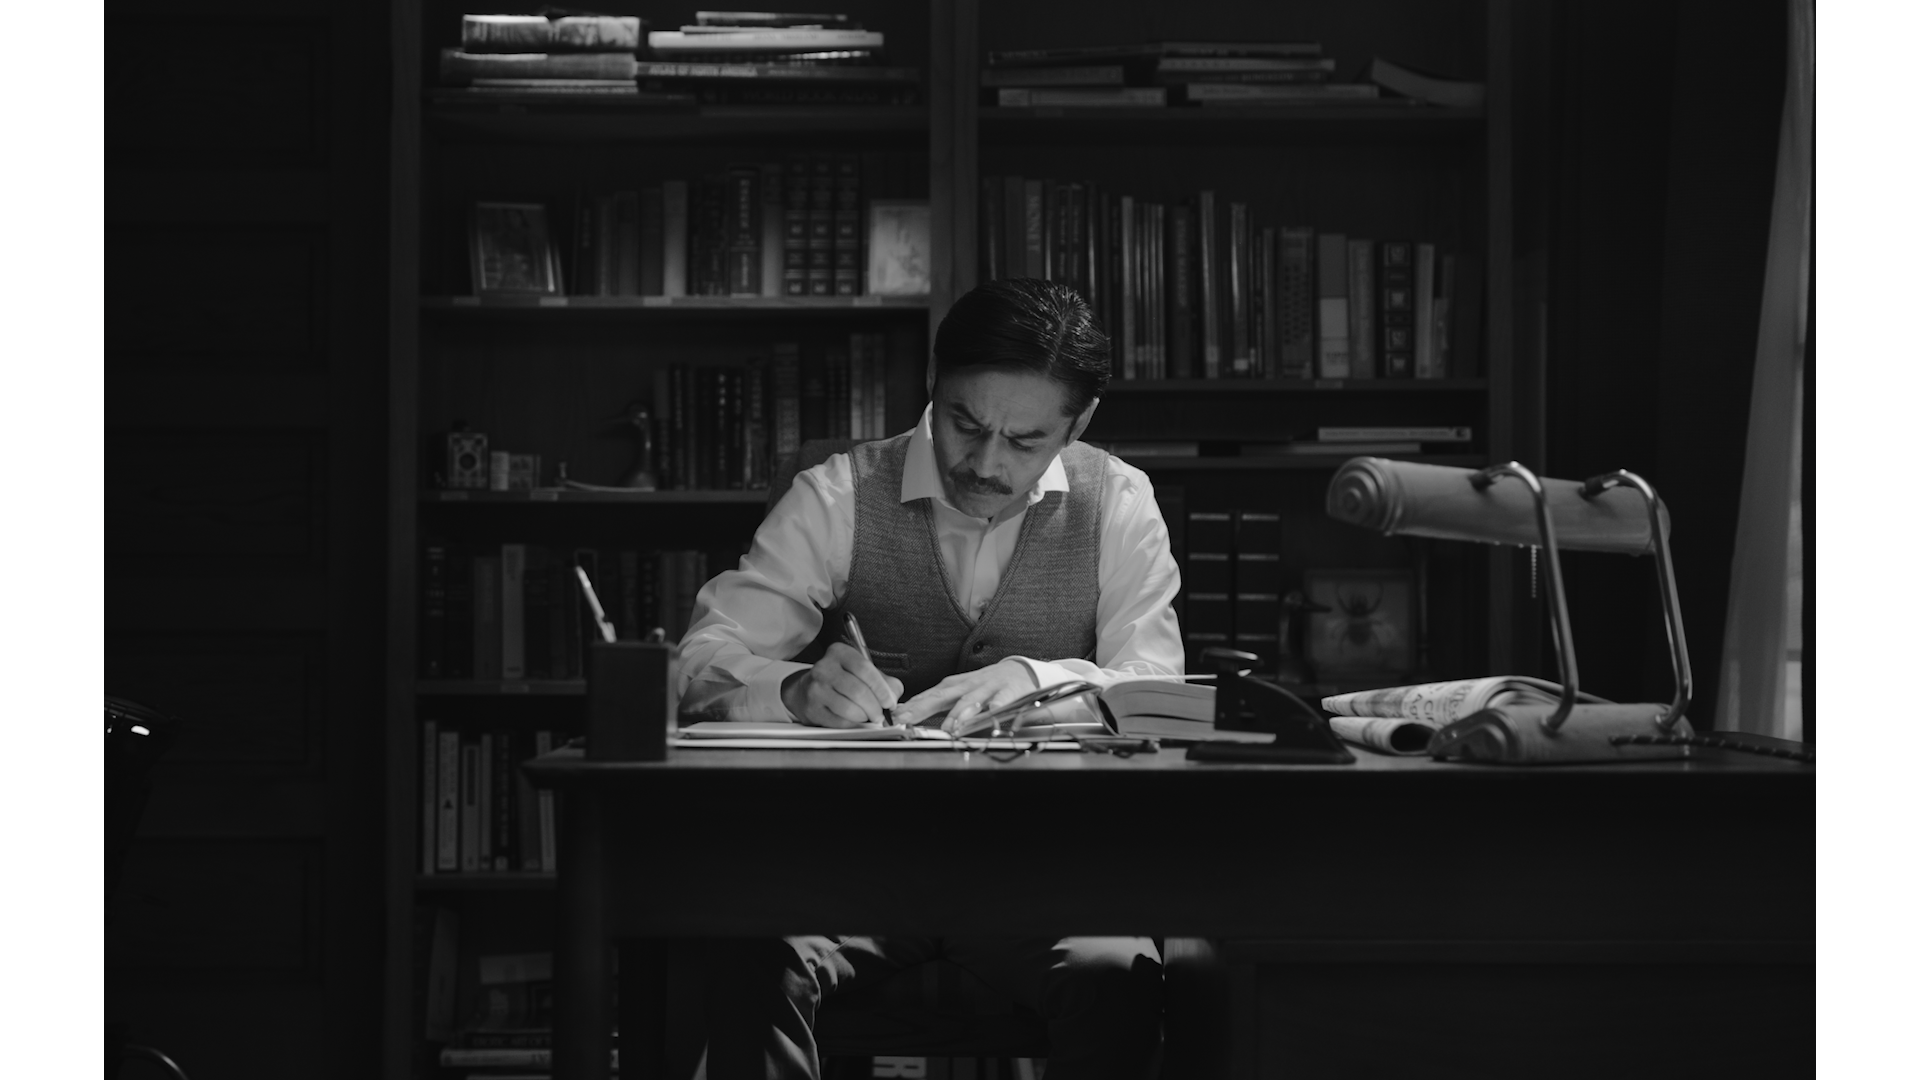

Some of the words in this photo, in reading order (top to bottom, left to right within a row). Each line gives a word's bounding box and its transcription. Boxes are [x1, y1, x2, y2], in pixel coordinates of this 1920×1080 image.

[677, 66, 689, 76] OF
[1026, 194, 1042, 254] MONET
[1176, 257, 1189, 308] MAKEUP
